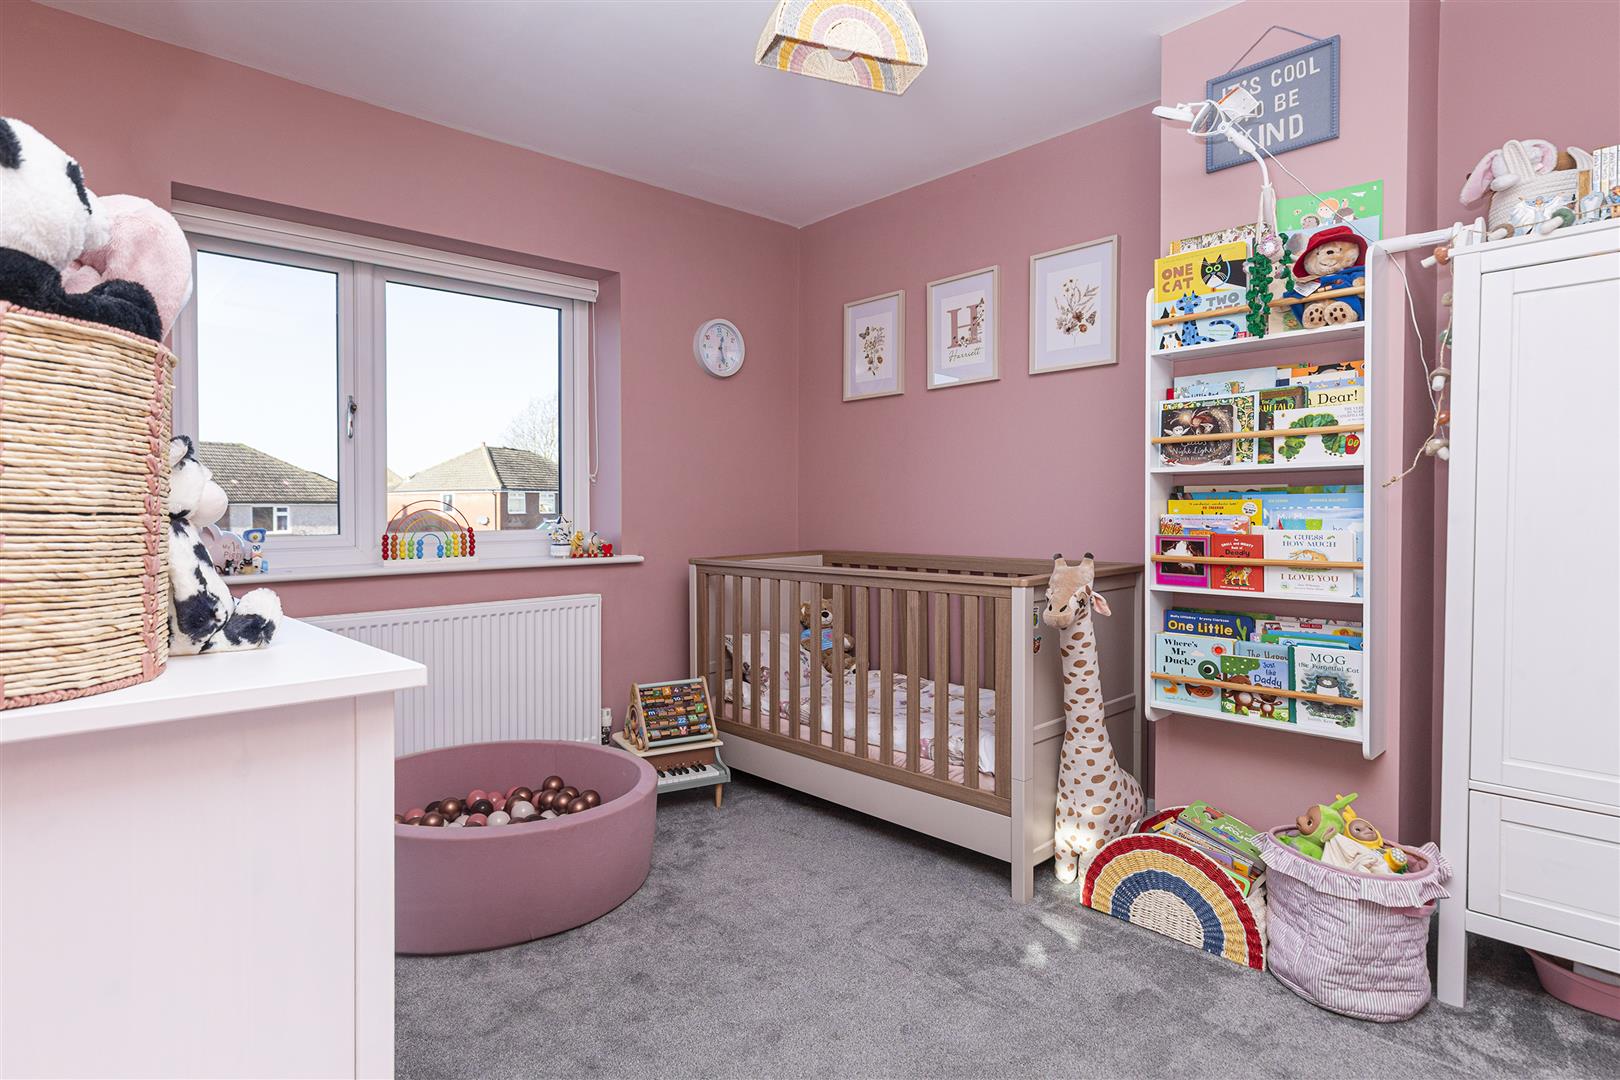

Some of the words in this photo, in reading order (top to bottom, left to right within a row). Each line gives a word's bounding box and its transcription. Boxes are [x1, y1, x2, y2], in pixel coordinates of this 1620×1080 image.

[1271, 56, 1320, 87] COOL
[1274, 88, 1300, 112] BE
[1162, 263, 1193, 280] ONE
[1162, 277, 1194, 293] CAT
[1206, 292, 1240, 307] TWO
[947, 304, 982, 349] H
[1318, 390, 1358, 405] Dear!
[1307, 540, 1337, 548] MUCH
[1225, 549, 1250, 557] Deadly
[1288, 573, 1315, 582] LOVE
[1317, 575, 1339, 583] YOU
[1168, 620, 1195, 632] One
[1197, 623, 1234, 636] Little
[1164, 638, 1199, 648] Where's
[1171, 647, 1187, 656] Mr
[1310, 653, 1347, 665] MOG
[1165, 655, 1197, 666] Duck?
[1311, 662, 1345, 672] Forgetful
[1254, 674, 1283, 689] Daddy
